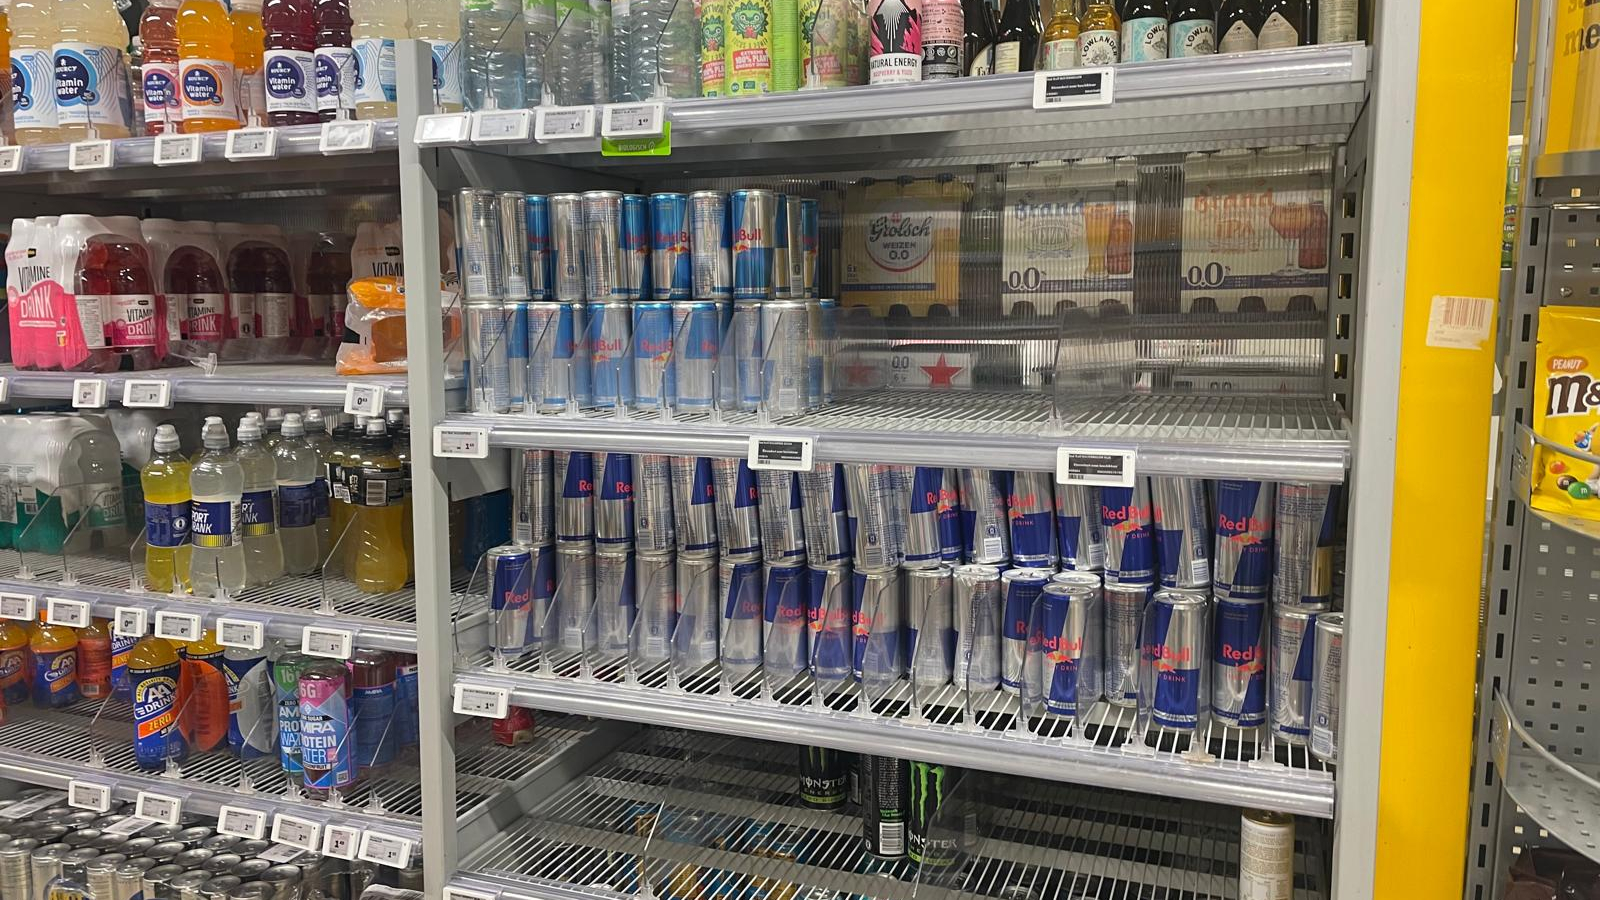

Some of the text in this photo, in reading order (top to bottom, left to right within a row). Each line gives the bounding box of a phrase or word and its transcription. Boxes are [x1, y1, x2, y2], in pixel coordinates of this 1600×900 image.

[1081, 36, 1119, 58] LOWLANDER
[897, 57, 918, 67] ENERGY
[186, 85, 214, 93] Vitamin
[269, 78, 296, 86] Vitamin
[738, 229, 761, 241] Bull
[869, 217, 932, 243] Grolsch
[883, 242, 917, 250] WEIZEN
[20, 289, 54, 319] DRINK
[1552, 359, 1583, 370] PEANUT
[1102, 505, 1126, 519] Red
[1219, 512, 1246, 531] Red
[504, 590, 529, 604] Red
[1222, 643, 1253, 661] Red
[147, 684, 171, 703] AA
[148, 713, 172, 732] ZERO
